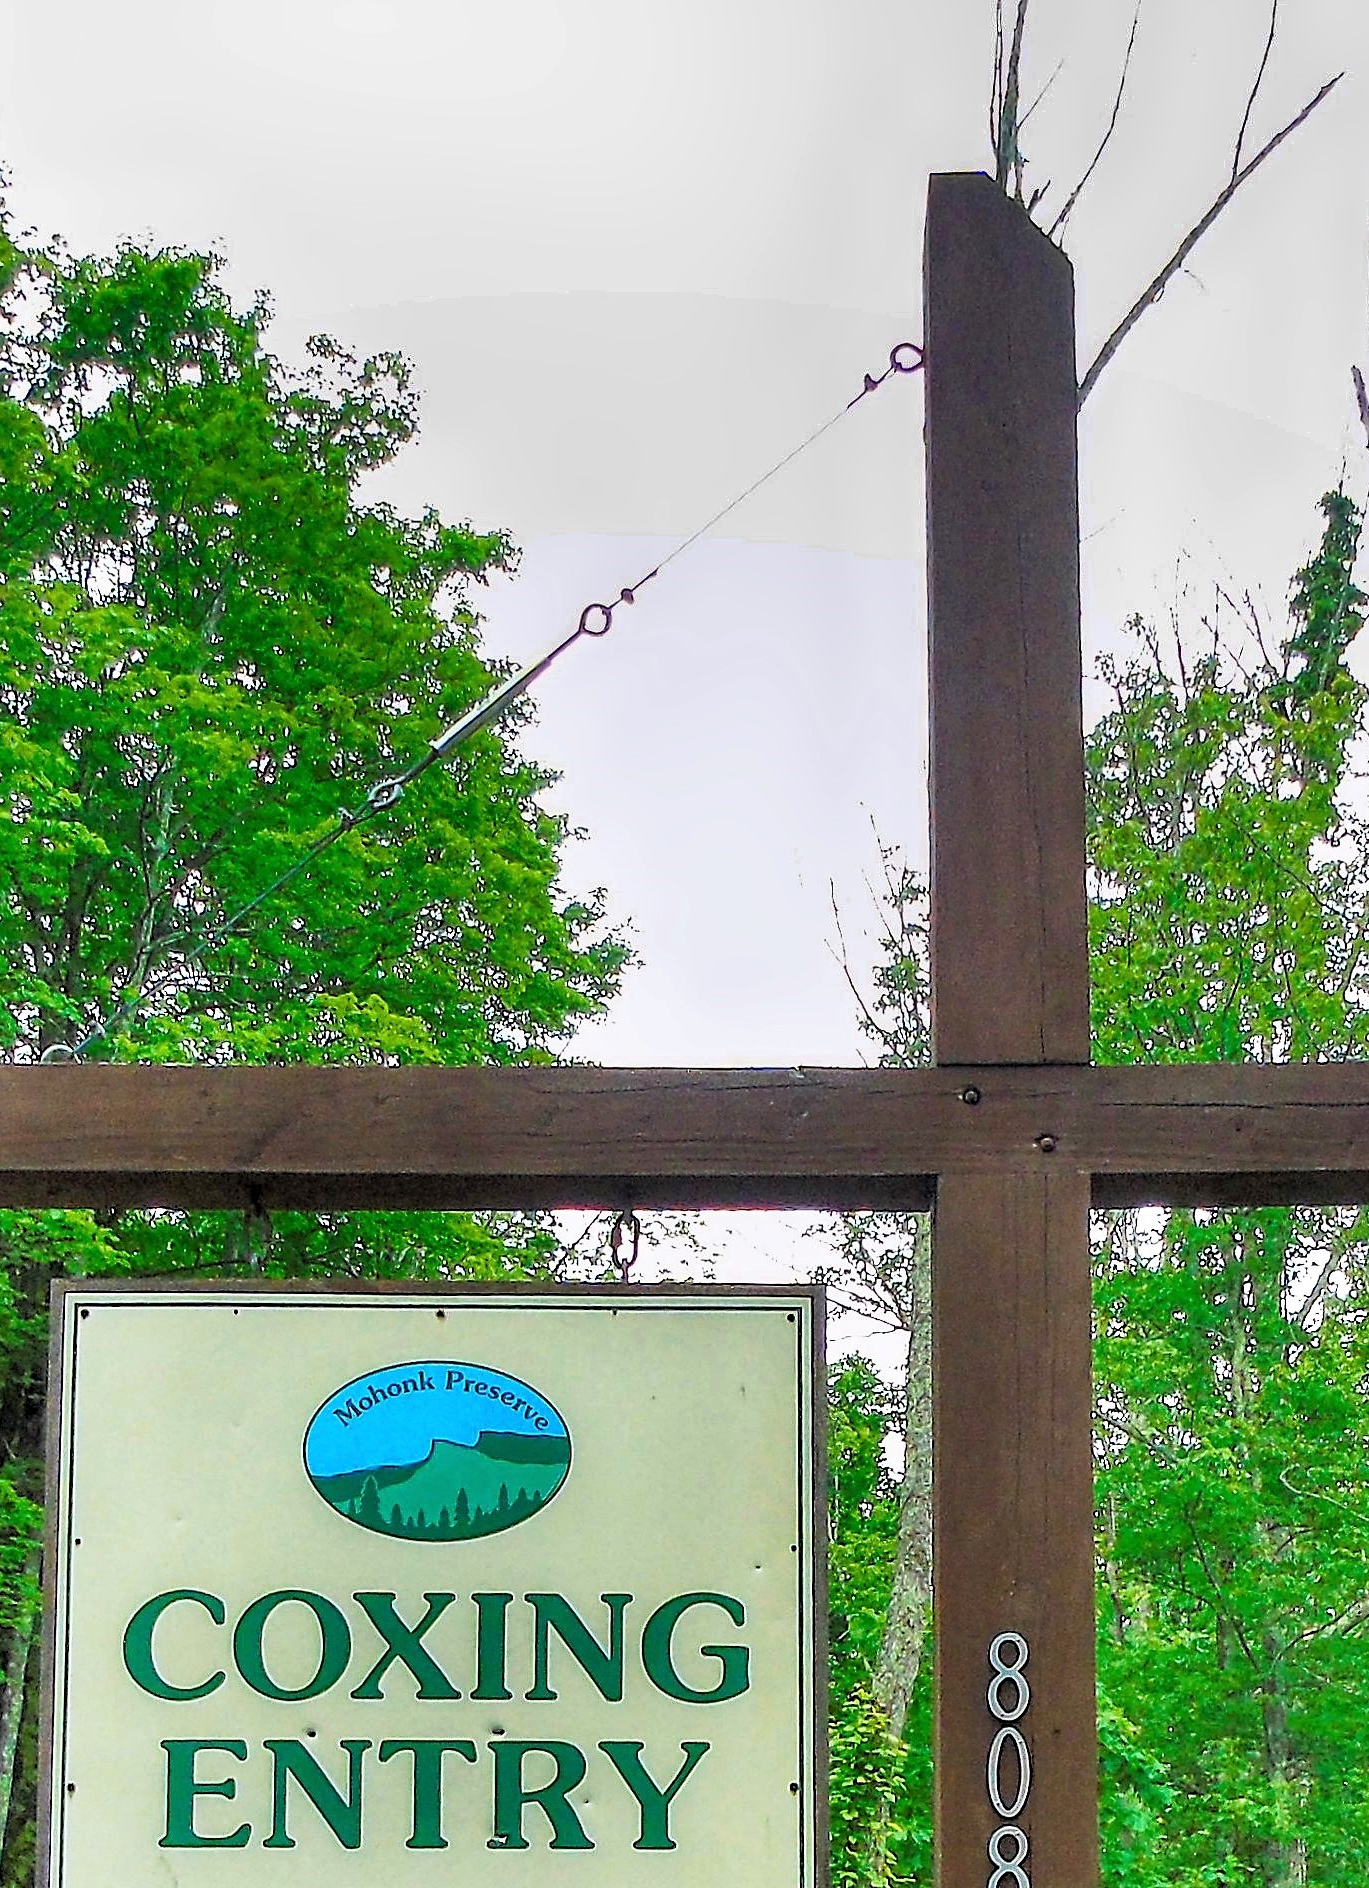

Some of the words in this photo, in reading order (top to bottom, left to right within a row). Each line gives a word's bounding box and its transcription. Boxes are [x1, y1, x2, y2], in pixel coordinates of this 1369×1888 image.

[332, 1371, 435, 1427] Mohonk
[445, 1370, 549, 1431] Preserve
[121, 1589, 752, 1703] COXING
[157, 1738, 711, 1850] ENTRY
